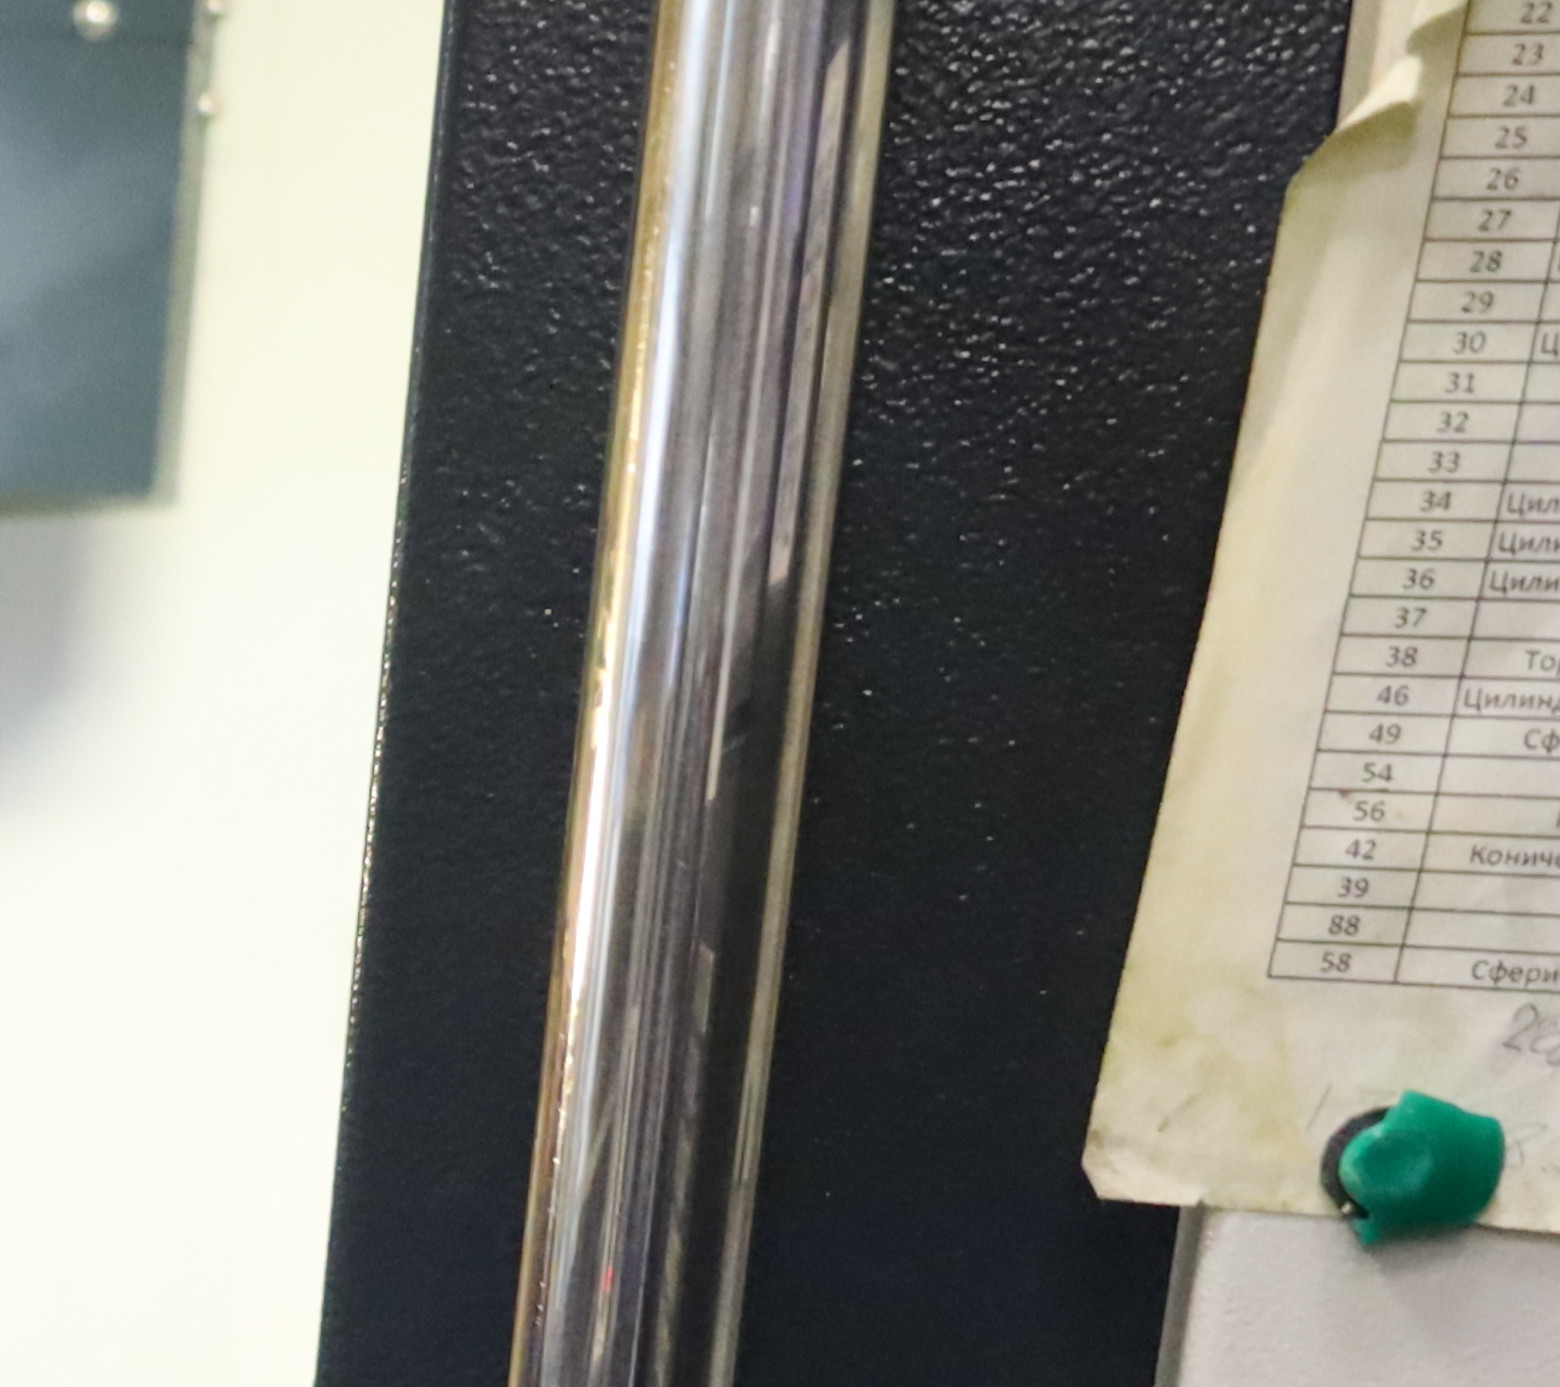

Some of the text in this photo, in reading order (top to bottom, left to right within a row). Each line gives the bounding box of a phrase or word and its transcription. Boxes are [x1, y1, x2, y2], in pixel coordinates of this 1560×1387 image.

[1519, 1, 1553, 25] 22
[1511, 42, 1545, 67] 23
[1503, 84, 1536, 107] 24
[1494, 125, 1528, 150] 25
[1486, 168, 1520, 191] 26
[1478, 209, 1512, 232] 27
[1469, 249, 1503, 274] 28
[1461, 290, 1495, 314] 29
[1454, 331, 1487, 354] 30
[1445, 371, 1475, 395] 31
[1438, 411, 1470, 434] 32
[1428, 451, 1461, 474] 33
[1420, 490, 1452, 512] 34
[1413, 530, 1443, 551] 35
[1404, 568, 1435, 590] 36
[1395, 606, 1428, 629] 37
[1387, 646, 1560, 674] 38 То
[1377, 685, 1409, 707] 46
[1368, 723, 1402, 745] 49
[1363, 762, 1393, 783] 54
[1353, 800, 1386, 822] 56
[1345, 839, 1378, 861] 42
[1338, 877, 1370, 899] 39
[1328, 914, 1361, 937] 88
[1321, 951, 1353, 973] 58
